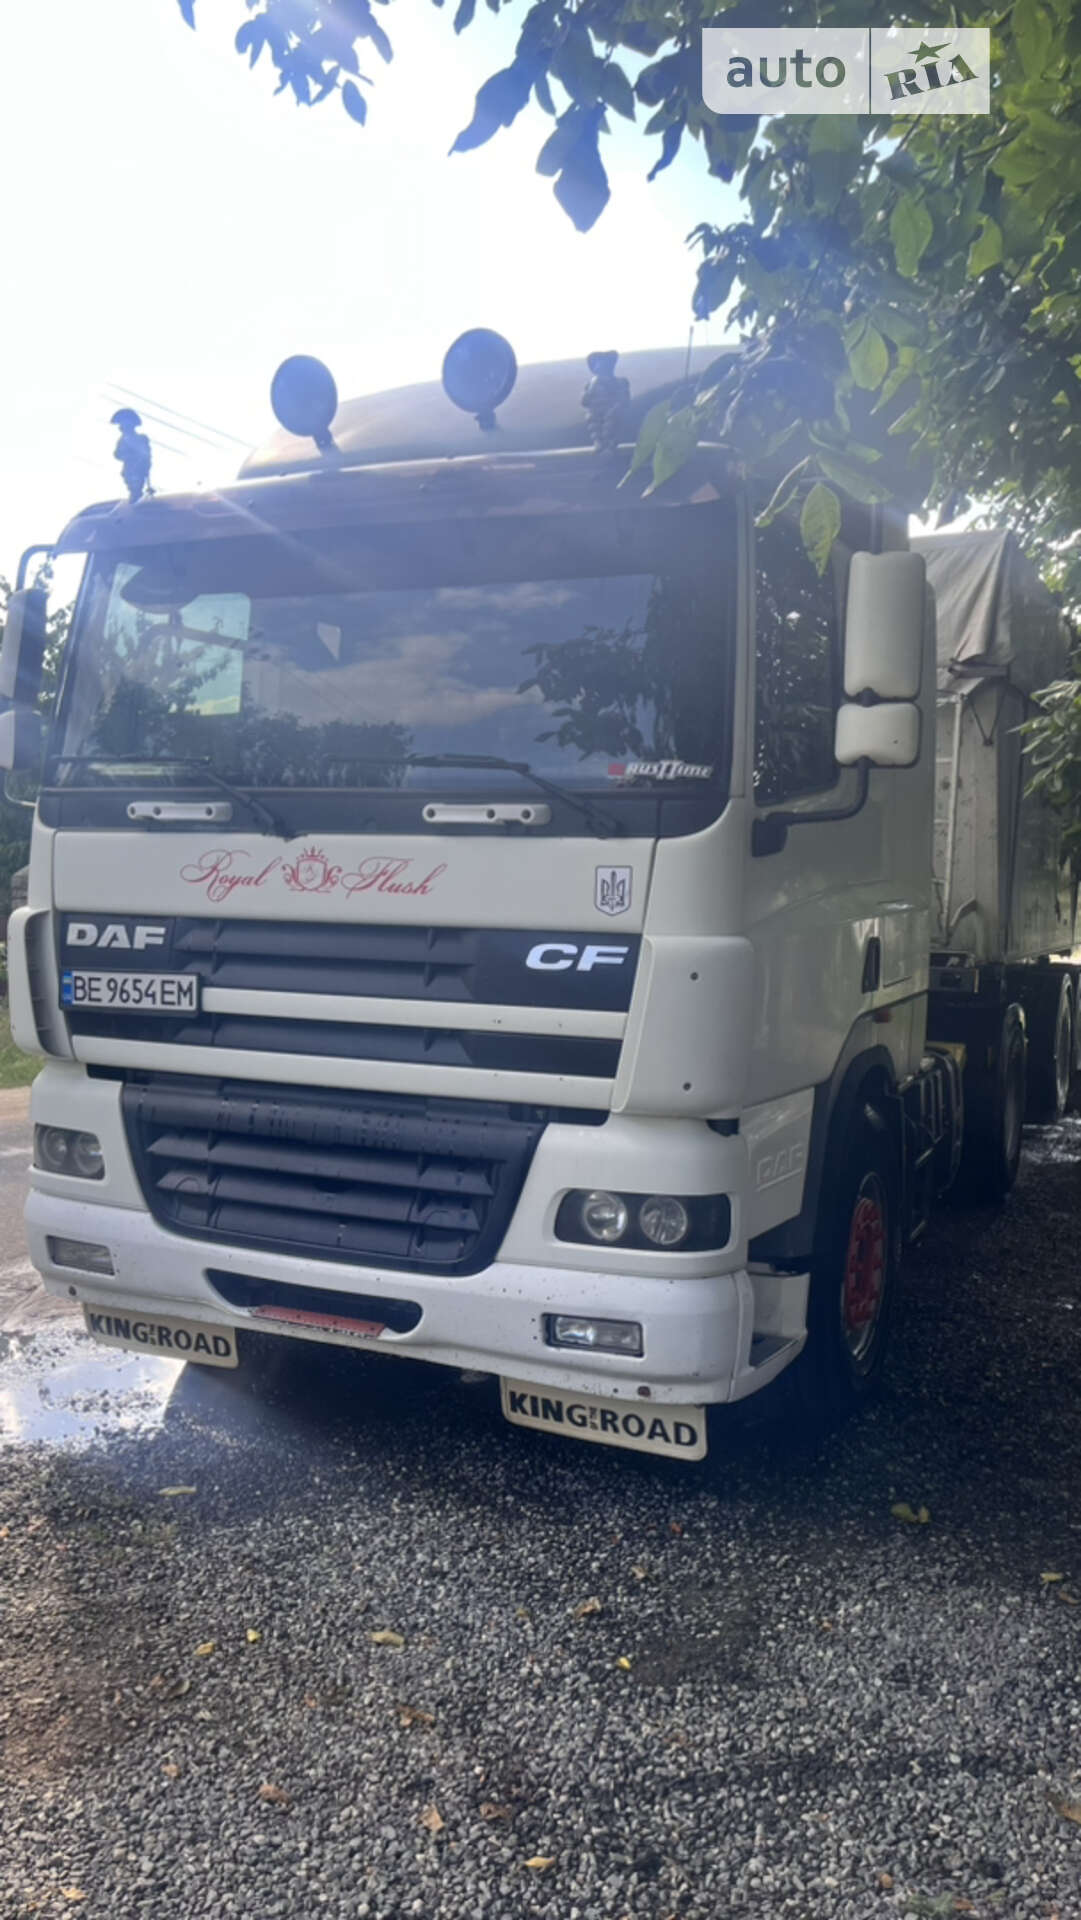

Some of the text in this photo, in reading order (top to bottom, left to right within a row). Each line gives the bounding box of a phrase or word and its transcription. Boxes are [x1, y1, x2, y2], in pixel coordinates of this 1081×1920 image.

[180, 849, 448, 903] Royal Flush
[66, 922, 166, 950] DAF
[525, 943, 629, 971] CF
[90, 1313, 148, 1344] KING
[158, 1325, 231, 1357] ROAD
[508, 1391, 588, 1428] KING
[600, 1408, 698, 1447] ROAD
